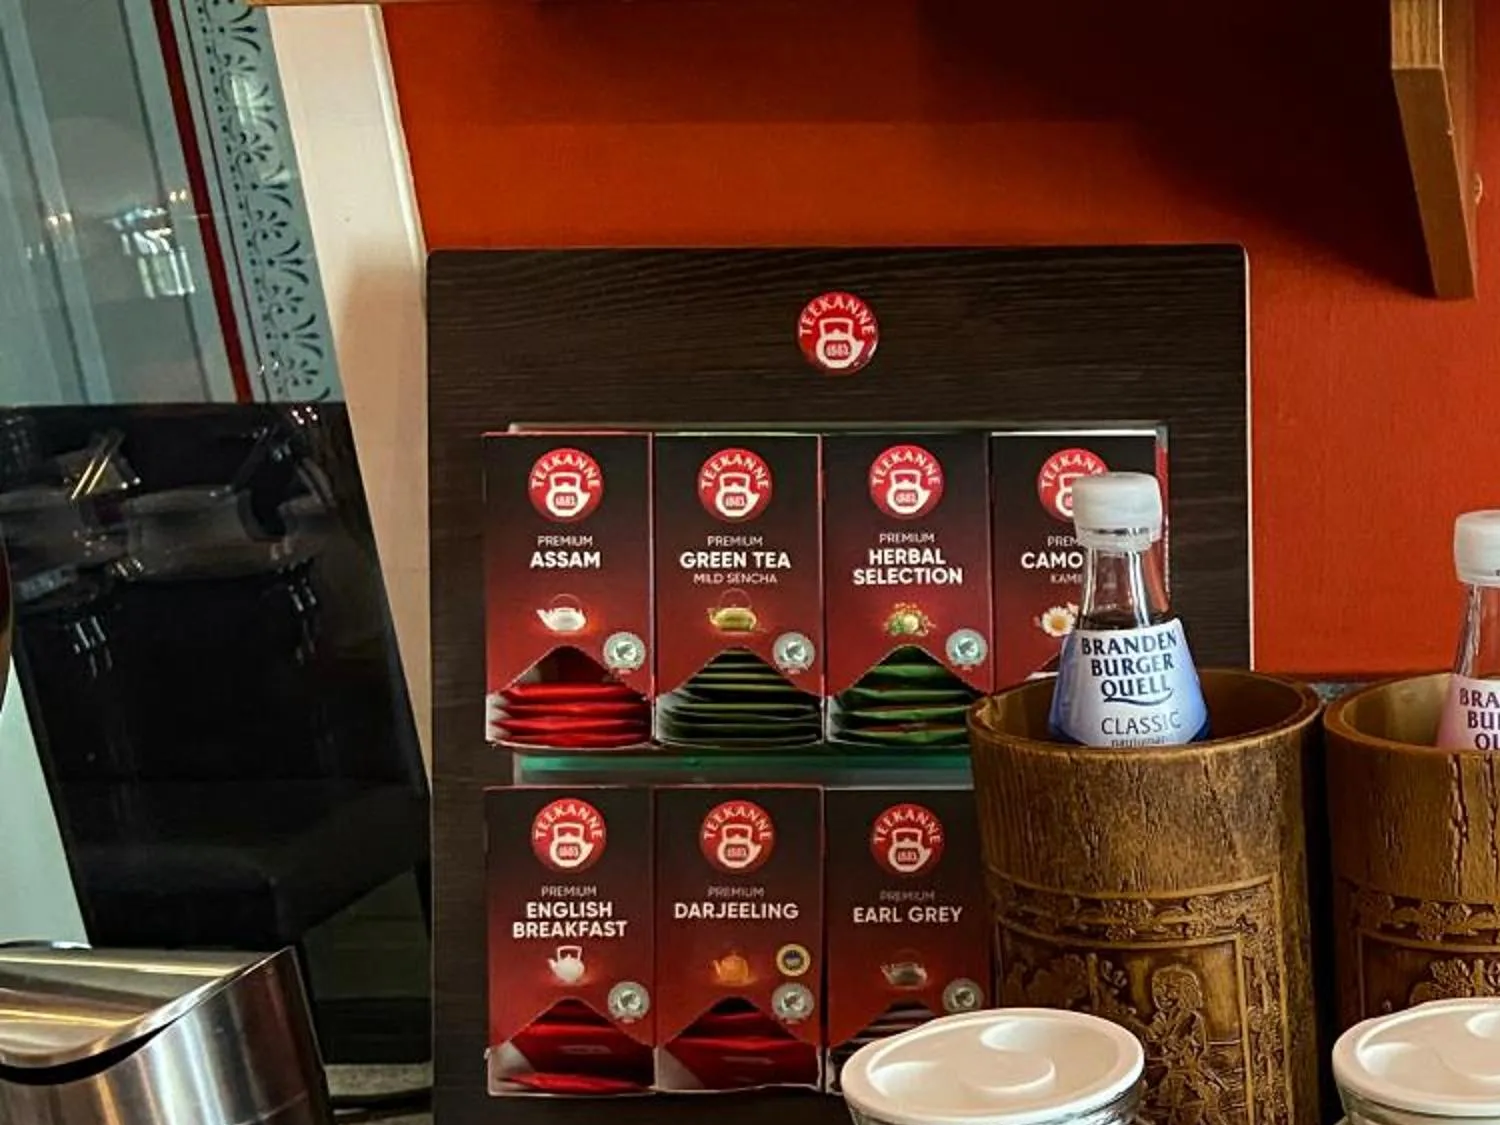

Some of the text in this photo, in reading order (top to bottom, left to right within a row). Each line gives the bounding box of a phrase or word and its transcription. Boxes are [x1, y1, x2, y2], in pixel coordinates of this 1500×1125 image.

[800, 296, 875, 337] TEEKANNE
[532, 453, 601, 489] TEEKANNE
[701, 453, 769, 490] TEEKANNE
[872, 450, 941, 486] TEEKANNE
[537, 535, 593, 547] PREMIUM
[707, 535, 764, 547] PREMIUM
[880, 533, 935, 544] PREMIUM
[1047, 535, 1081, 547] PREM
[529, 551, 602, 569] ASSAM
[680, 551, 792, 569] GREEN TEA
[868, 548, 947, 566] HERBAL
[1021, 551, 1084, 569] CAMO
[693, 573, 779, 584] MILD SENCHA
[853, 567, 963, 585] SELECTION
[1050, 573, 1083, 584] KAMI
[1081, 630, 1177, 656] BRANDEN
[1091, 652, 1175, 677] BURGER
[1101, 675, 1173, 705] QUELL
[1101, 710, 1182, 735] CLASSIC
[535, 803, 603, 840] TEEKANNE
[704, 805, 772, 841] TEEKANNE
[873, 809, 941, 844] TEEKANNE
[541, 886, 597, 897] PREMIUM
[708, 886, 764, 897] PREMIUM
[526, 901, 613, 919] ENGLISH
[674, 902, 799, 919] DARJEELING
[853, 906, 963, 923] EARL GREY
[513, 920, 628, 939] BREAKFAST
